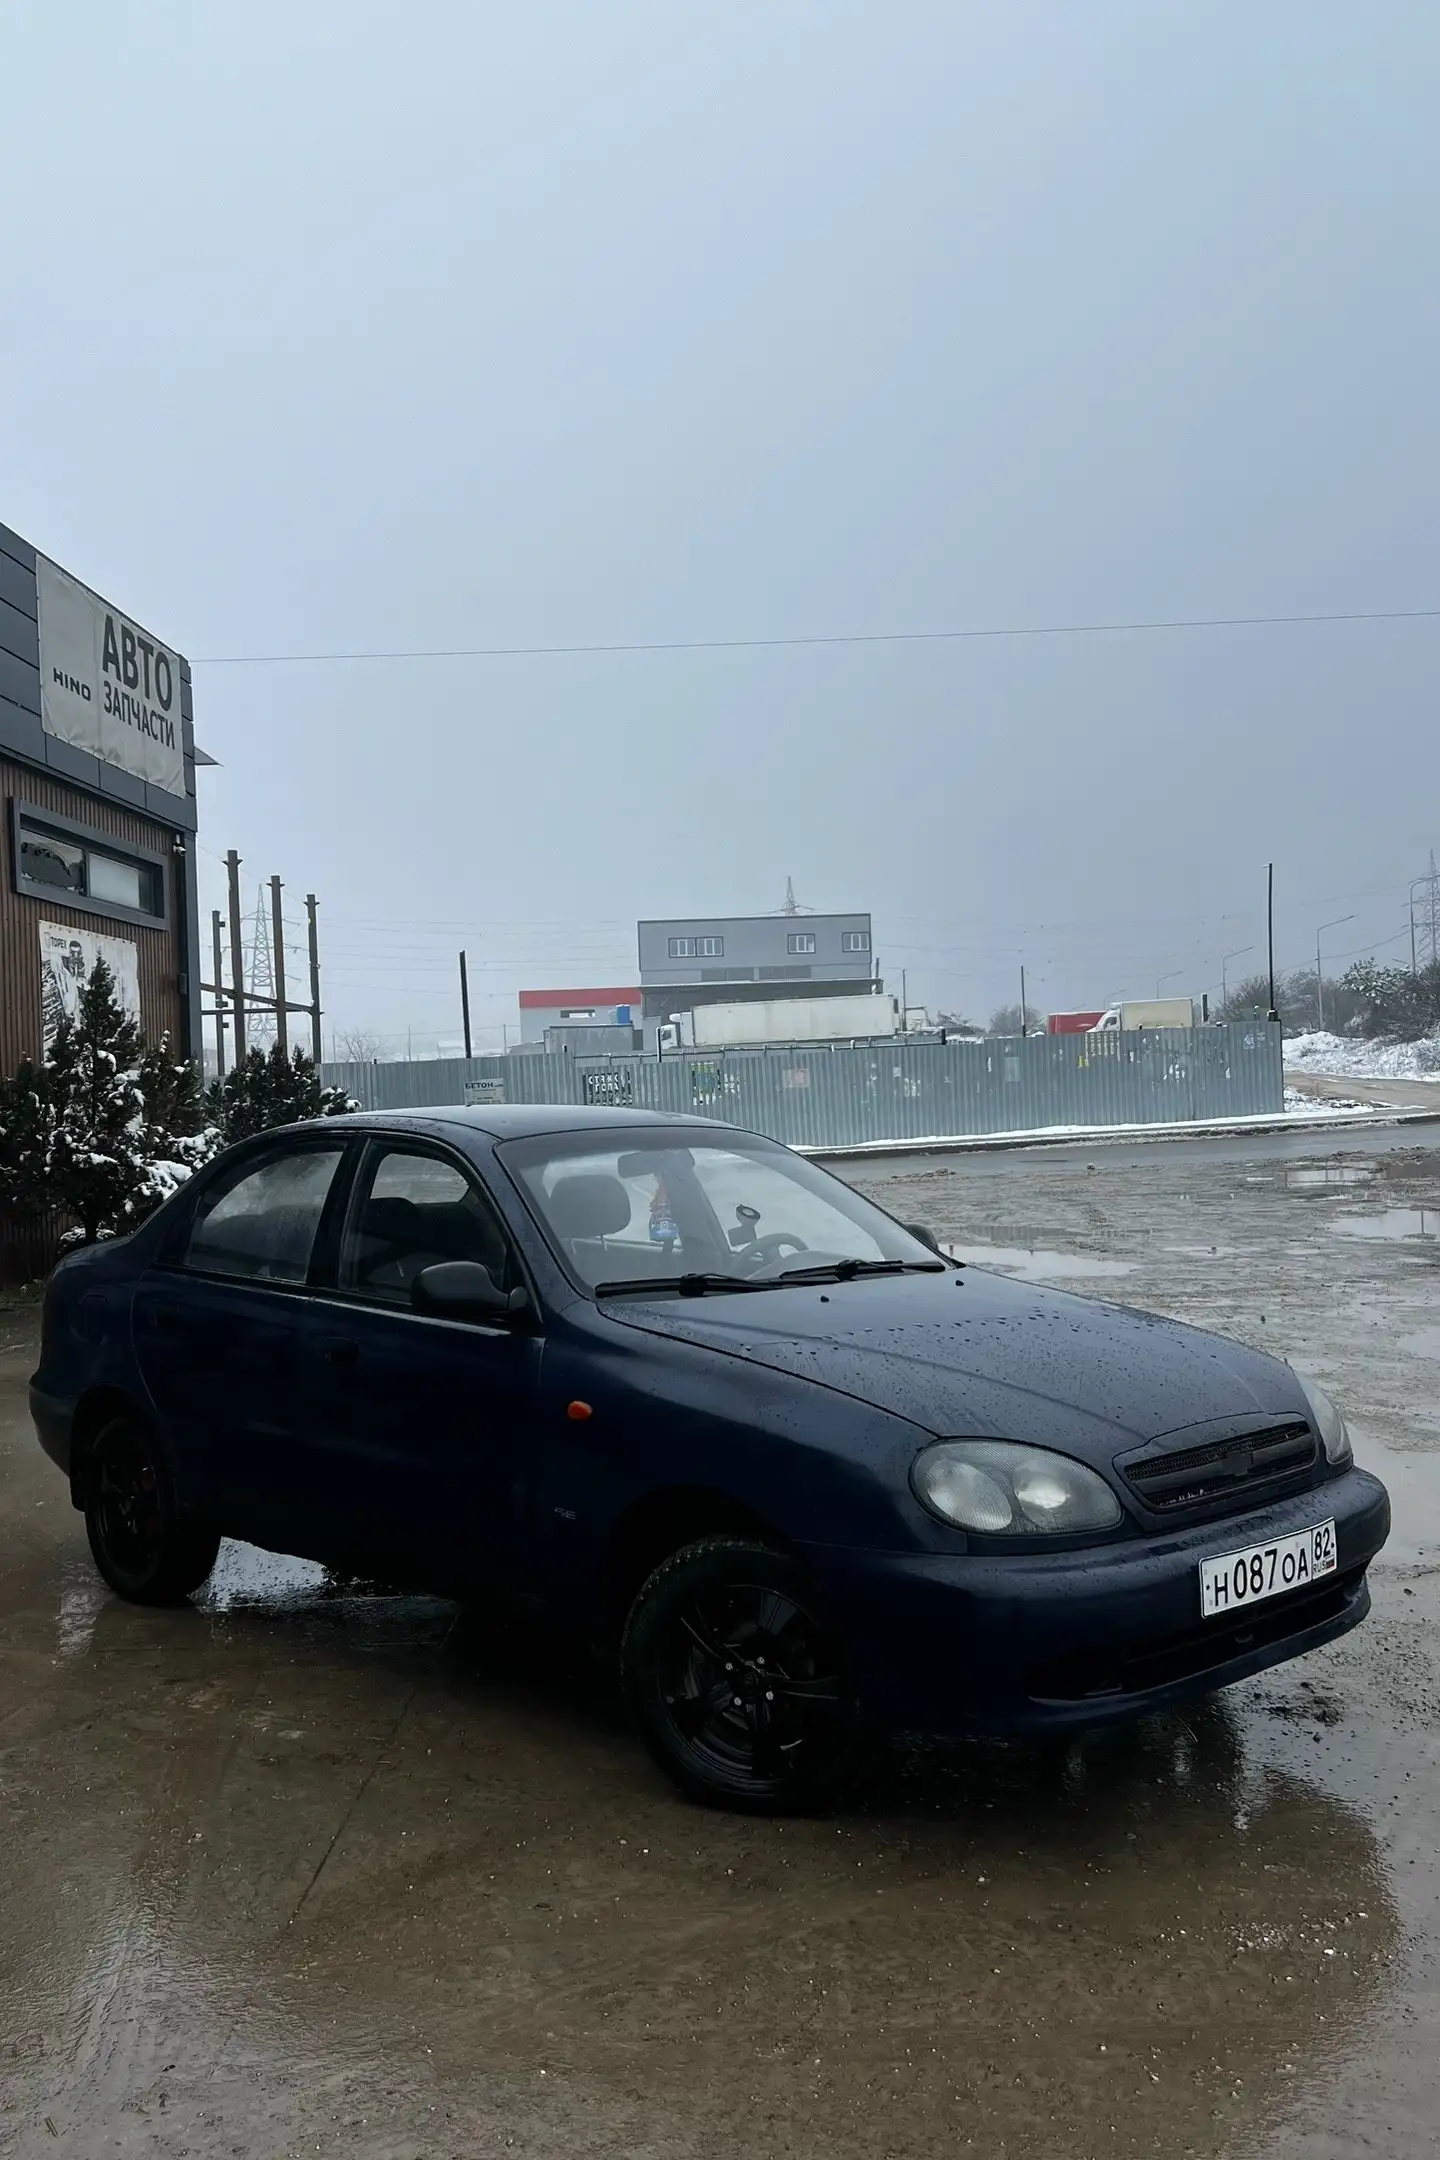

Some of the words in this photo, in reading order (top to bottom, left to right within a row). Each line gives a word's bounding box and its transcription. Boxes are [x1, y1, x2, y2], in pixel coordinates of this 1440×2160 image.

[102, 614, 173, 712] АВТО
[53, 667, 92, 702] HINO
[103, 680, 176, 750] ЗАПЧАСТИ
[465, 1082, 494, 1090] БЕТОН
[1314, 1527, 1331, 1560] 82
[1313, 1560, 1327, 1573] RUS
